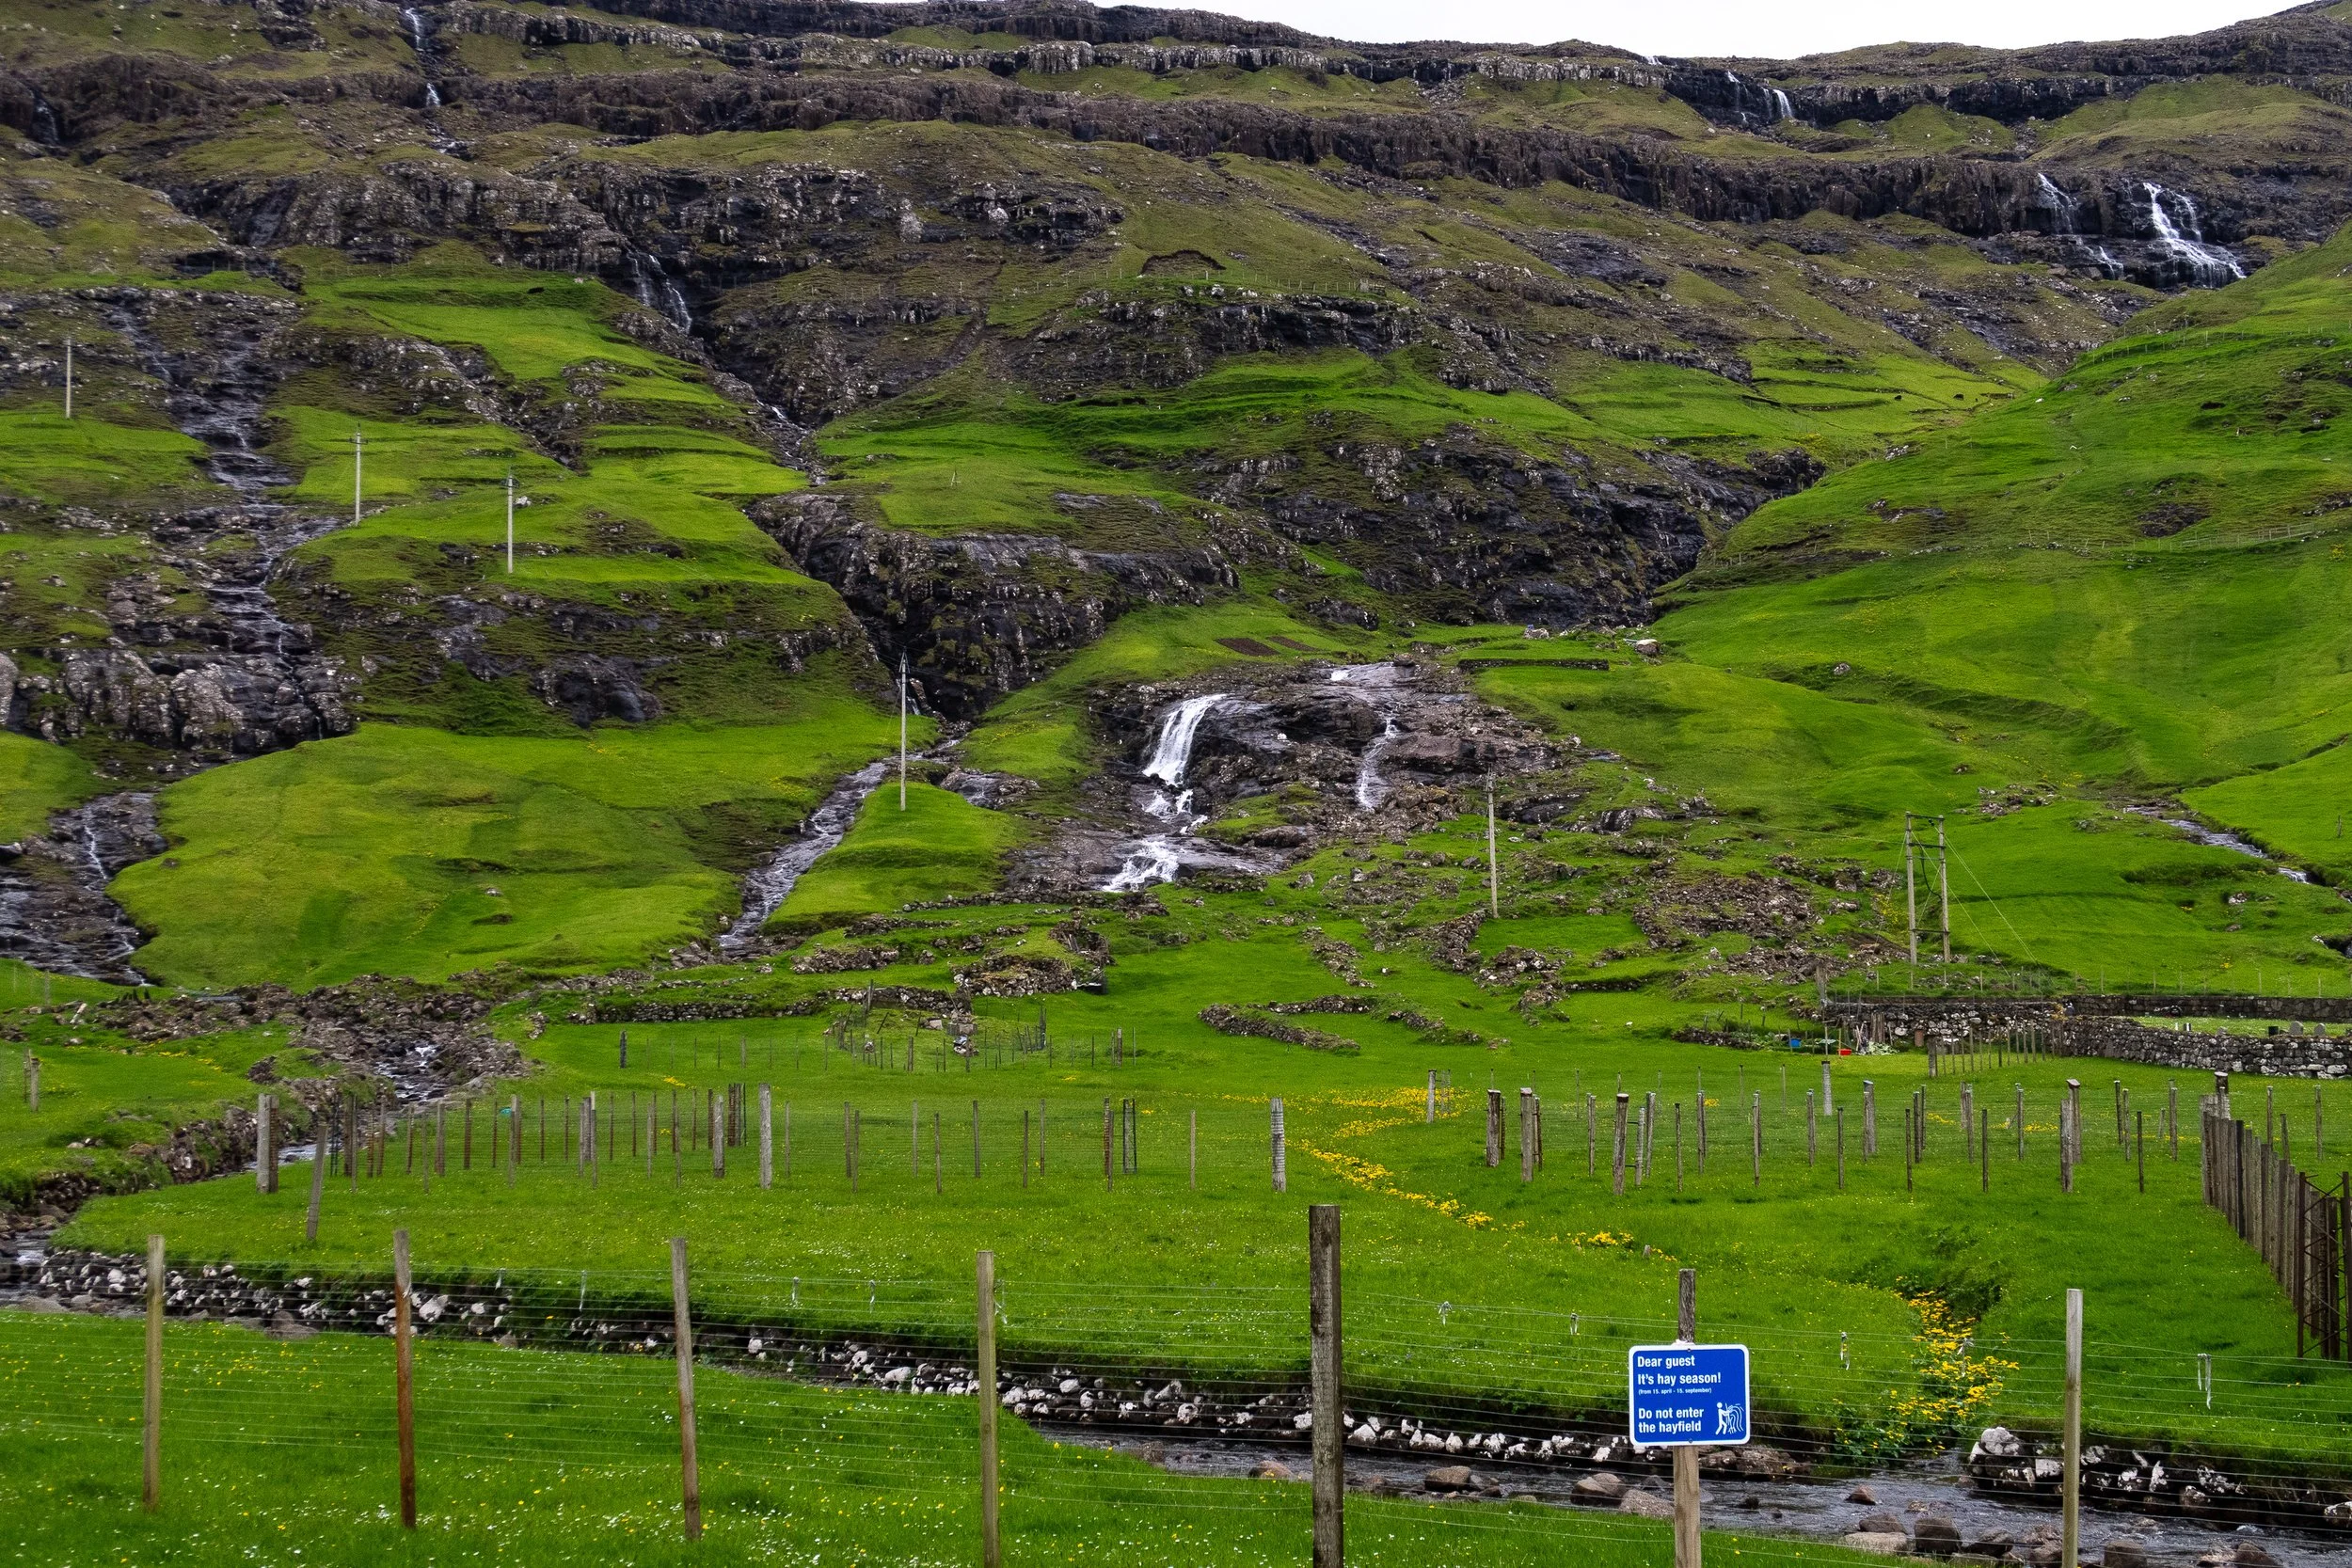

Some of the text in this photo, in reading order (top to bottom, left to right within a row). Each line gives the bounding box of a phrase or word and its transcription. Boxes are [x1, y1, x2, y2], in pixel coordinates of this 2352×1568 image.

[1637, 1354, 1695, 1369] Dear guest
[1637, 1371, 1722, 1386] It's hay season!
[1638, 1407, 1705, 1419] Do not enter
[1638, 1420, 1702, 1433] the hayfield
